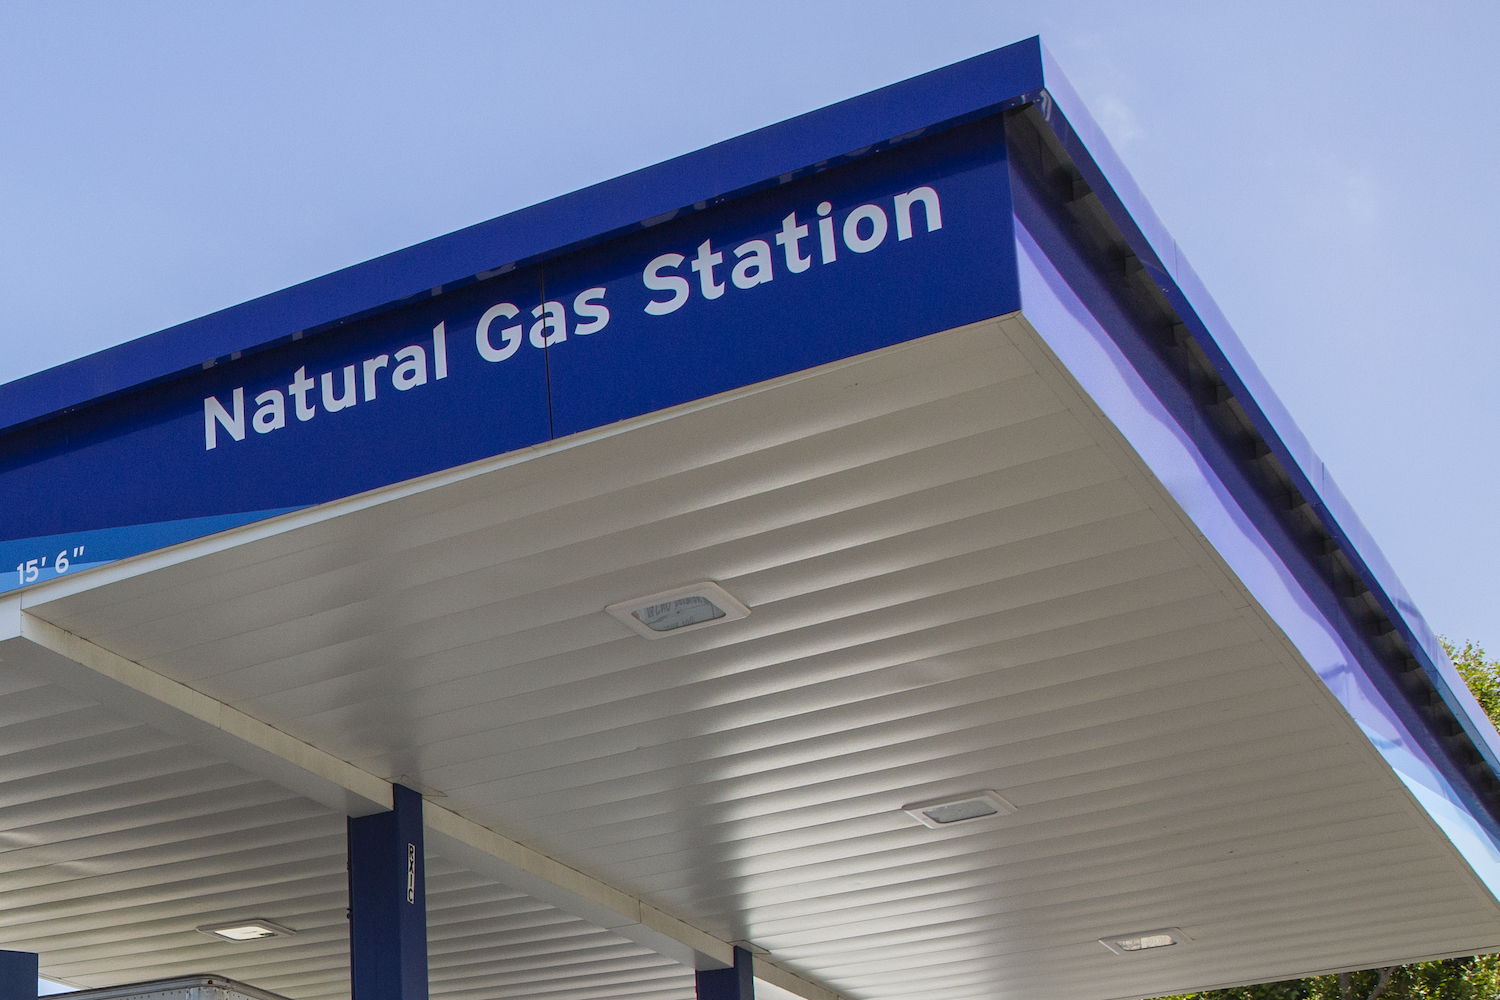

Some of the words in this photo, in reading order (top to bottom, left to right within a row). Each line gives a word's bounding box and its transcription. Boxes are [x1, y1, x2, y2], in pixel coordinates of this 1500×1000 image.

[203, 321, 447, 450] Natural
[475, 286, 609, 364] Gas
[642, 185, 944, 317] Station
